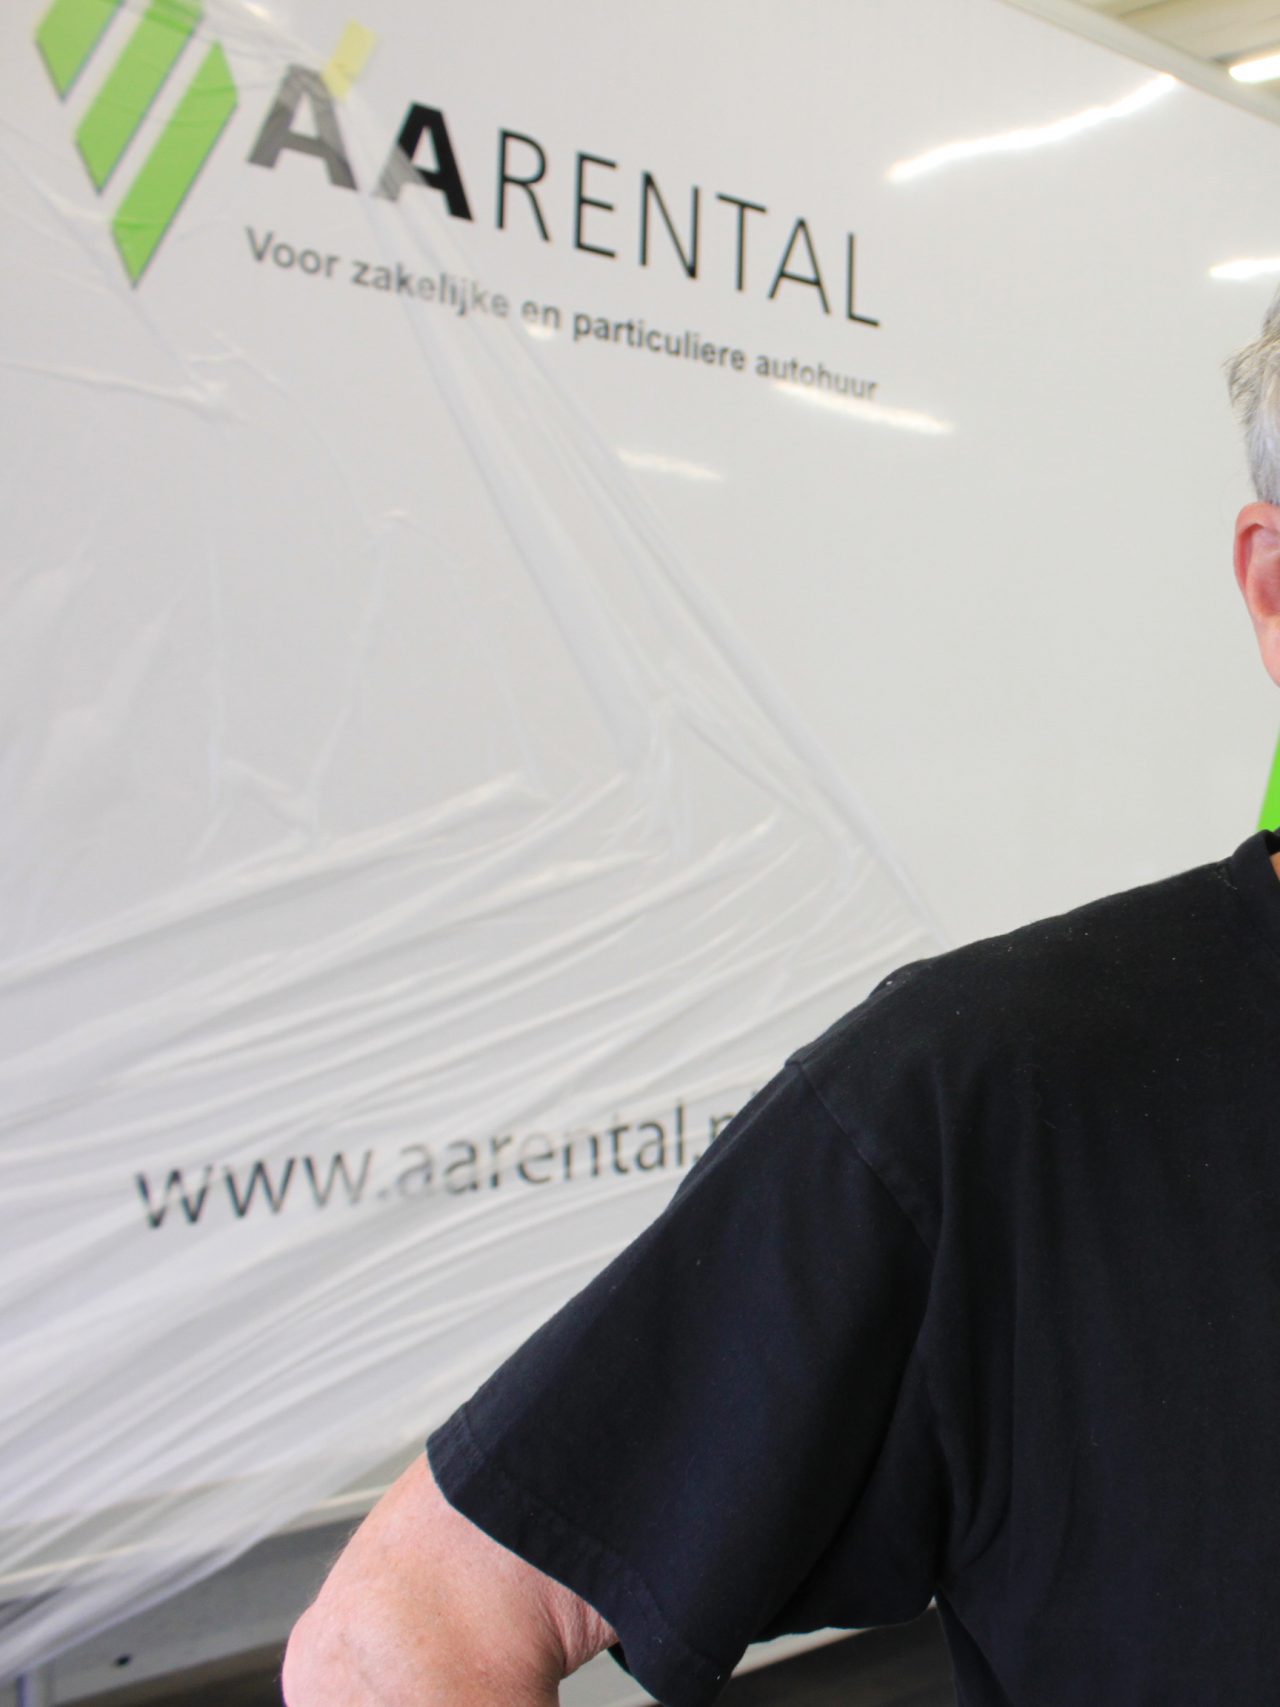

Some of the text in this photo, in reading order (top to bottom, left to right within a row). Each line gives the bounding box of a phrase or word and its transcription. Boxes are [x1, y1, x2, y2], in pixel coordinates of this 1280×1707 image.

[245, 226, 880, 399] Voor zakelijke en particuliere autohuur
[134, 1088, 757, 1230] www.aarental.
